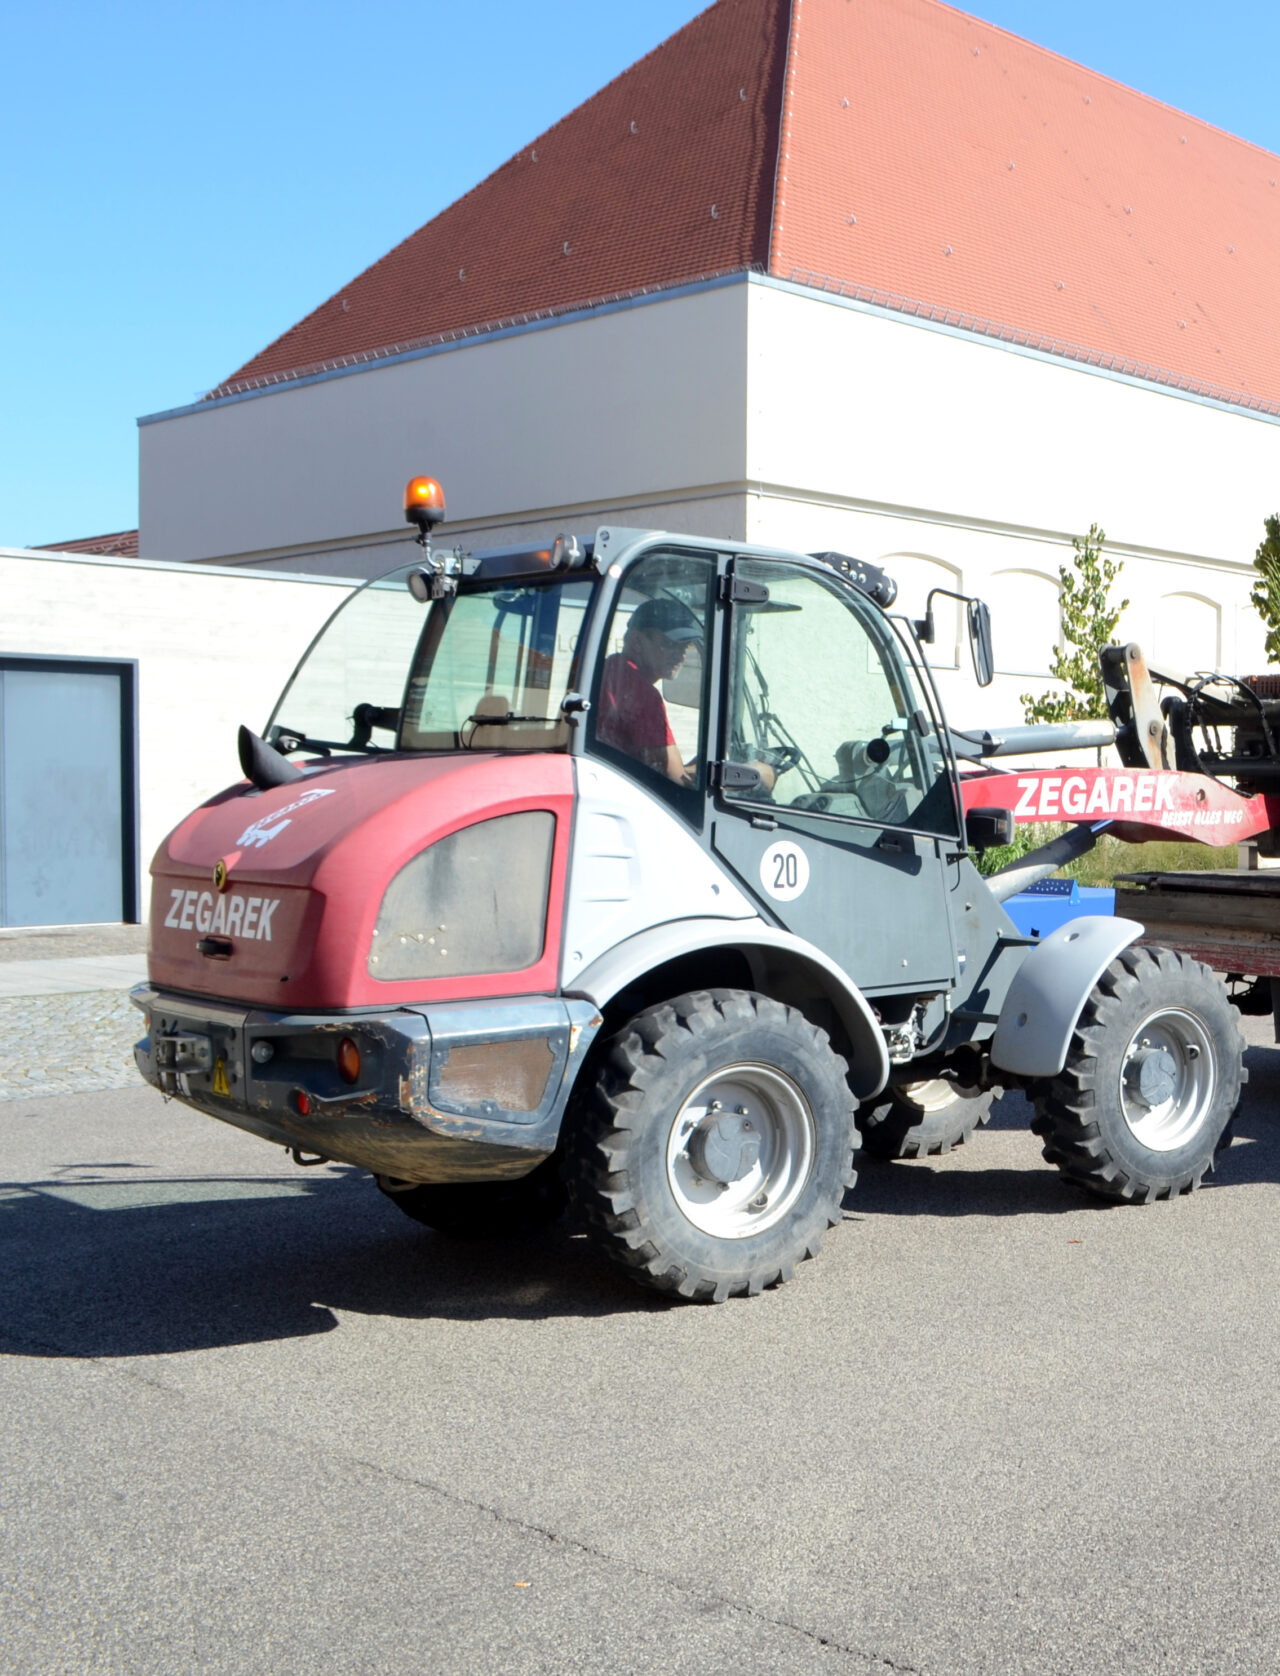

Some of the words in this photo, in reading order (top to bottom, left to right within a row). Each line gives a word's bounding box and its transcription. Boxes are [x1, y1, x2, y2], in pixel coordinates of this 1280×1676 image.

[1014, 775, 1179, 816] ZEGAREK
[1194, 809, 1221, 825] ALLES
[1223, 809, 1243, 824] WEG
[773, 853, 797, 888] 20
[164, 888, 280, 942] ZEGAREK
